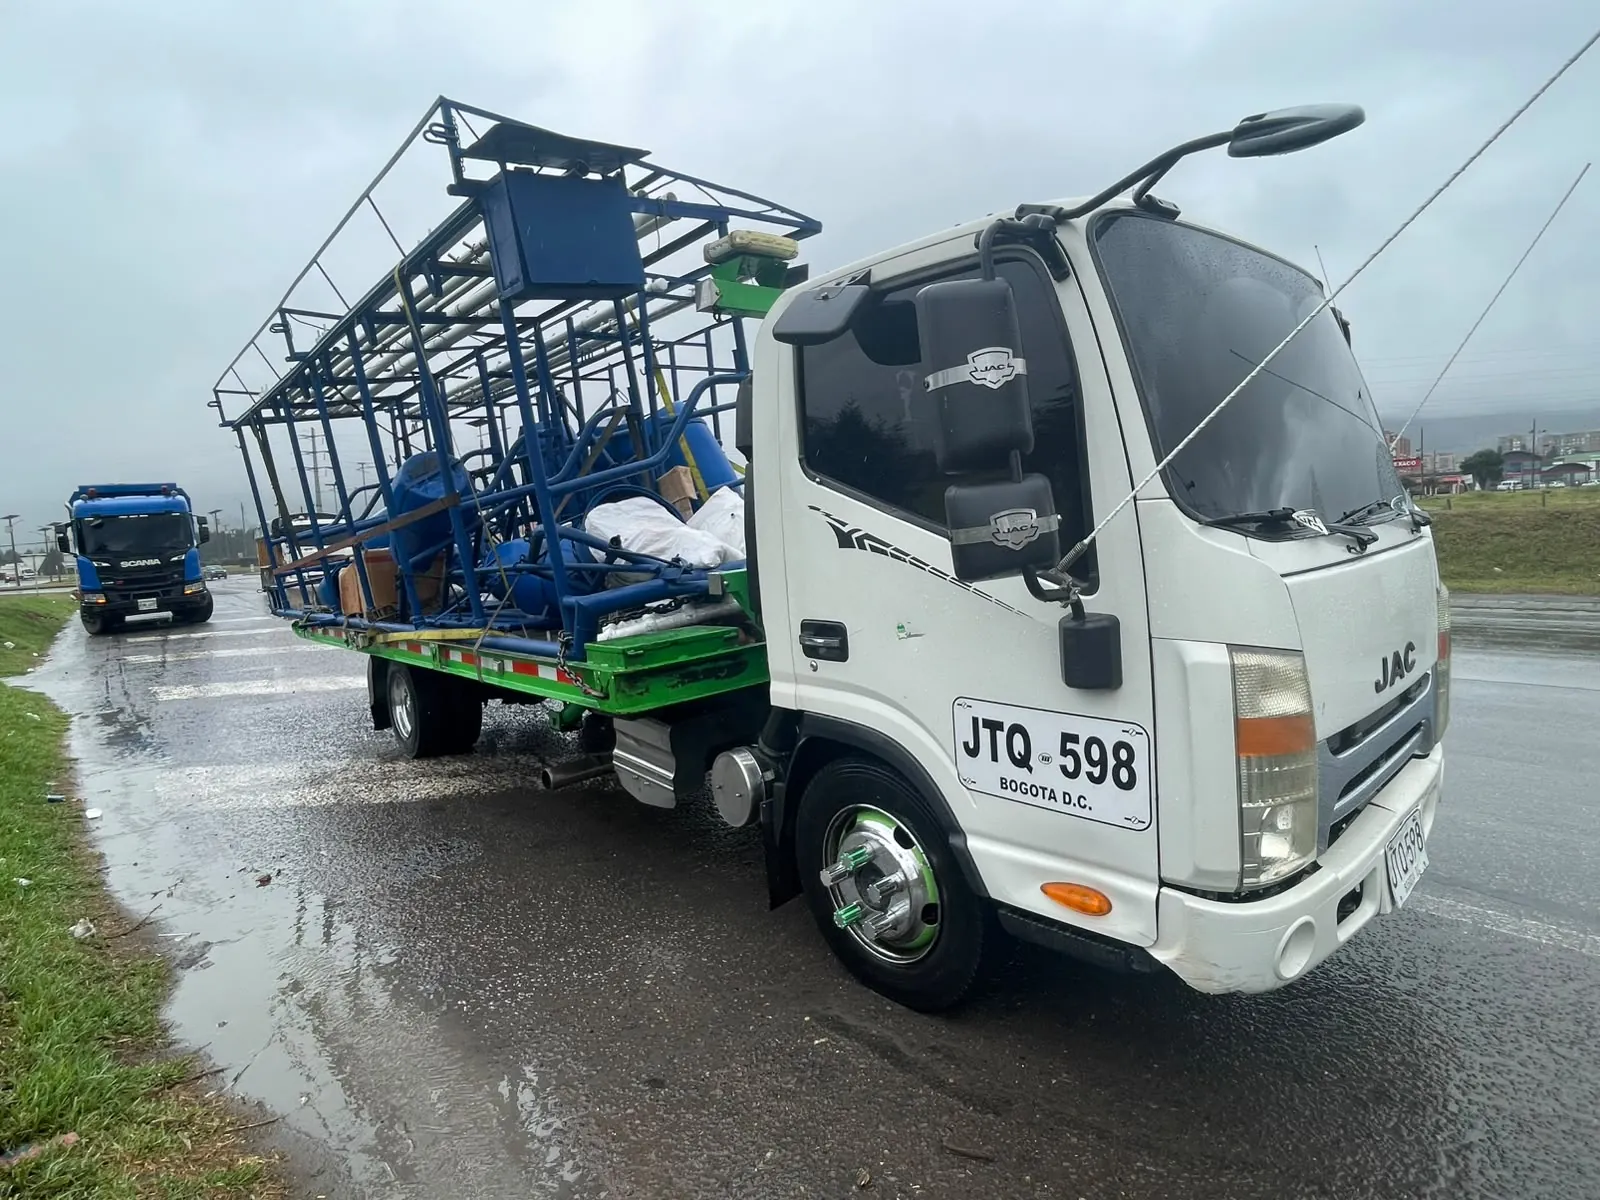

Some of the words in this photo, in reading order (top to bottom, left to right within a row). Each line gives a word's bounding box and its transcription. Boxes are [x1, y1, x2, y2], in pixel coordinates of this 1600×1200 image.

[980, 364, 1006, 372] JAC
[1002, 525, 1029, 533] JAC
[120, 558, 161, 568] SCANIA
[1375, 641, 1416, 694] JAC
[962, 715, 1033, 775] JTQ
[1059, 731, 1138, 791] 598
[999, 776, 1058, 803] BOGOTA
[1062, 790, 1094, 812] D.C.
